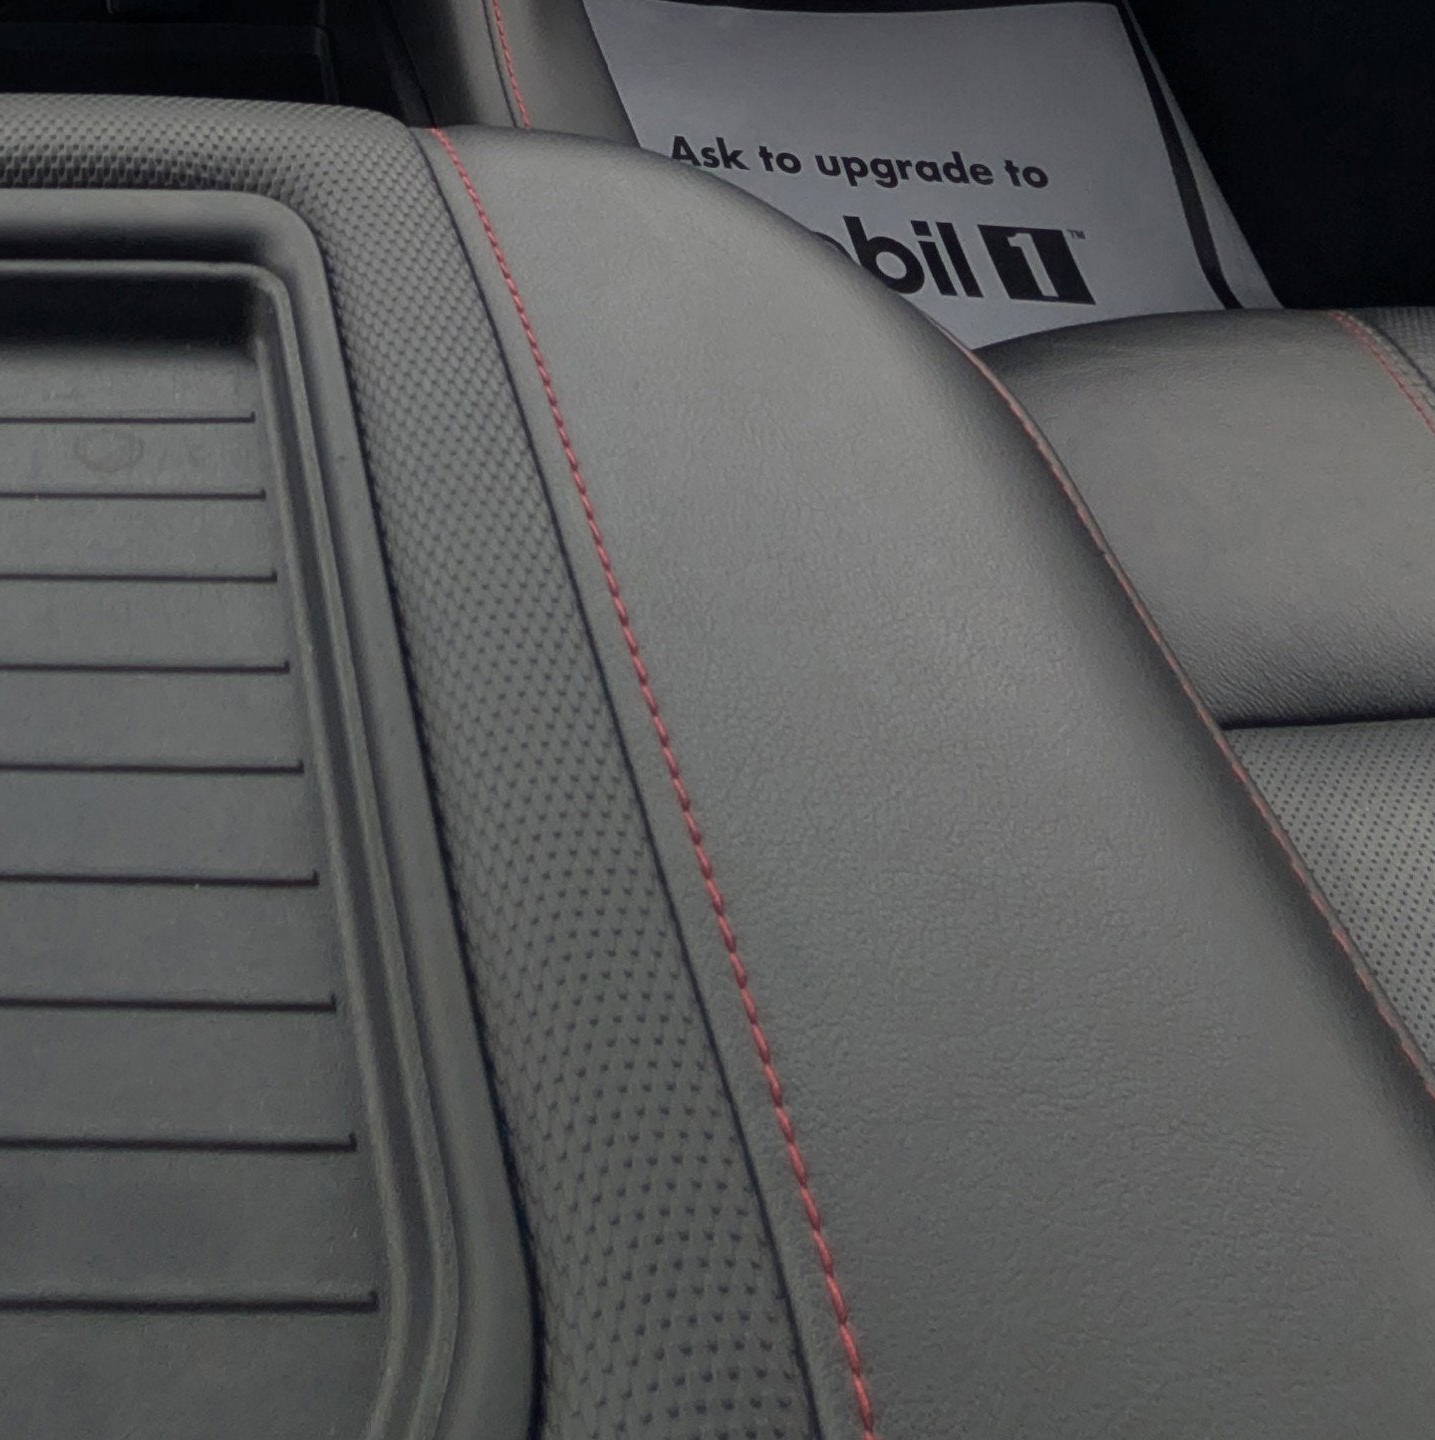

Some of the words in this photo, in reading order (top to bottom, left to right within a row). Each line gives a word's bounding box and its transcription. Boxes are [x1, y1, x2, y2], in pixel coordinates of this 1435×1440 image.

[670, 134, 748, 172] Ask
[759, 144, 802, 175] to
[815, 151, 994, 189] upgrade
[1005, 156, 1049, 190] to
